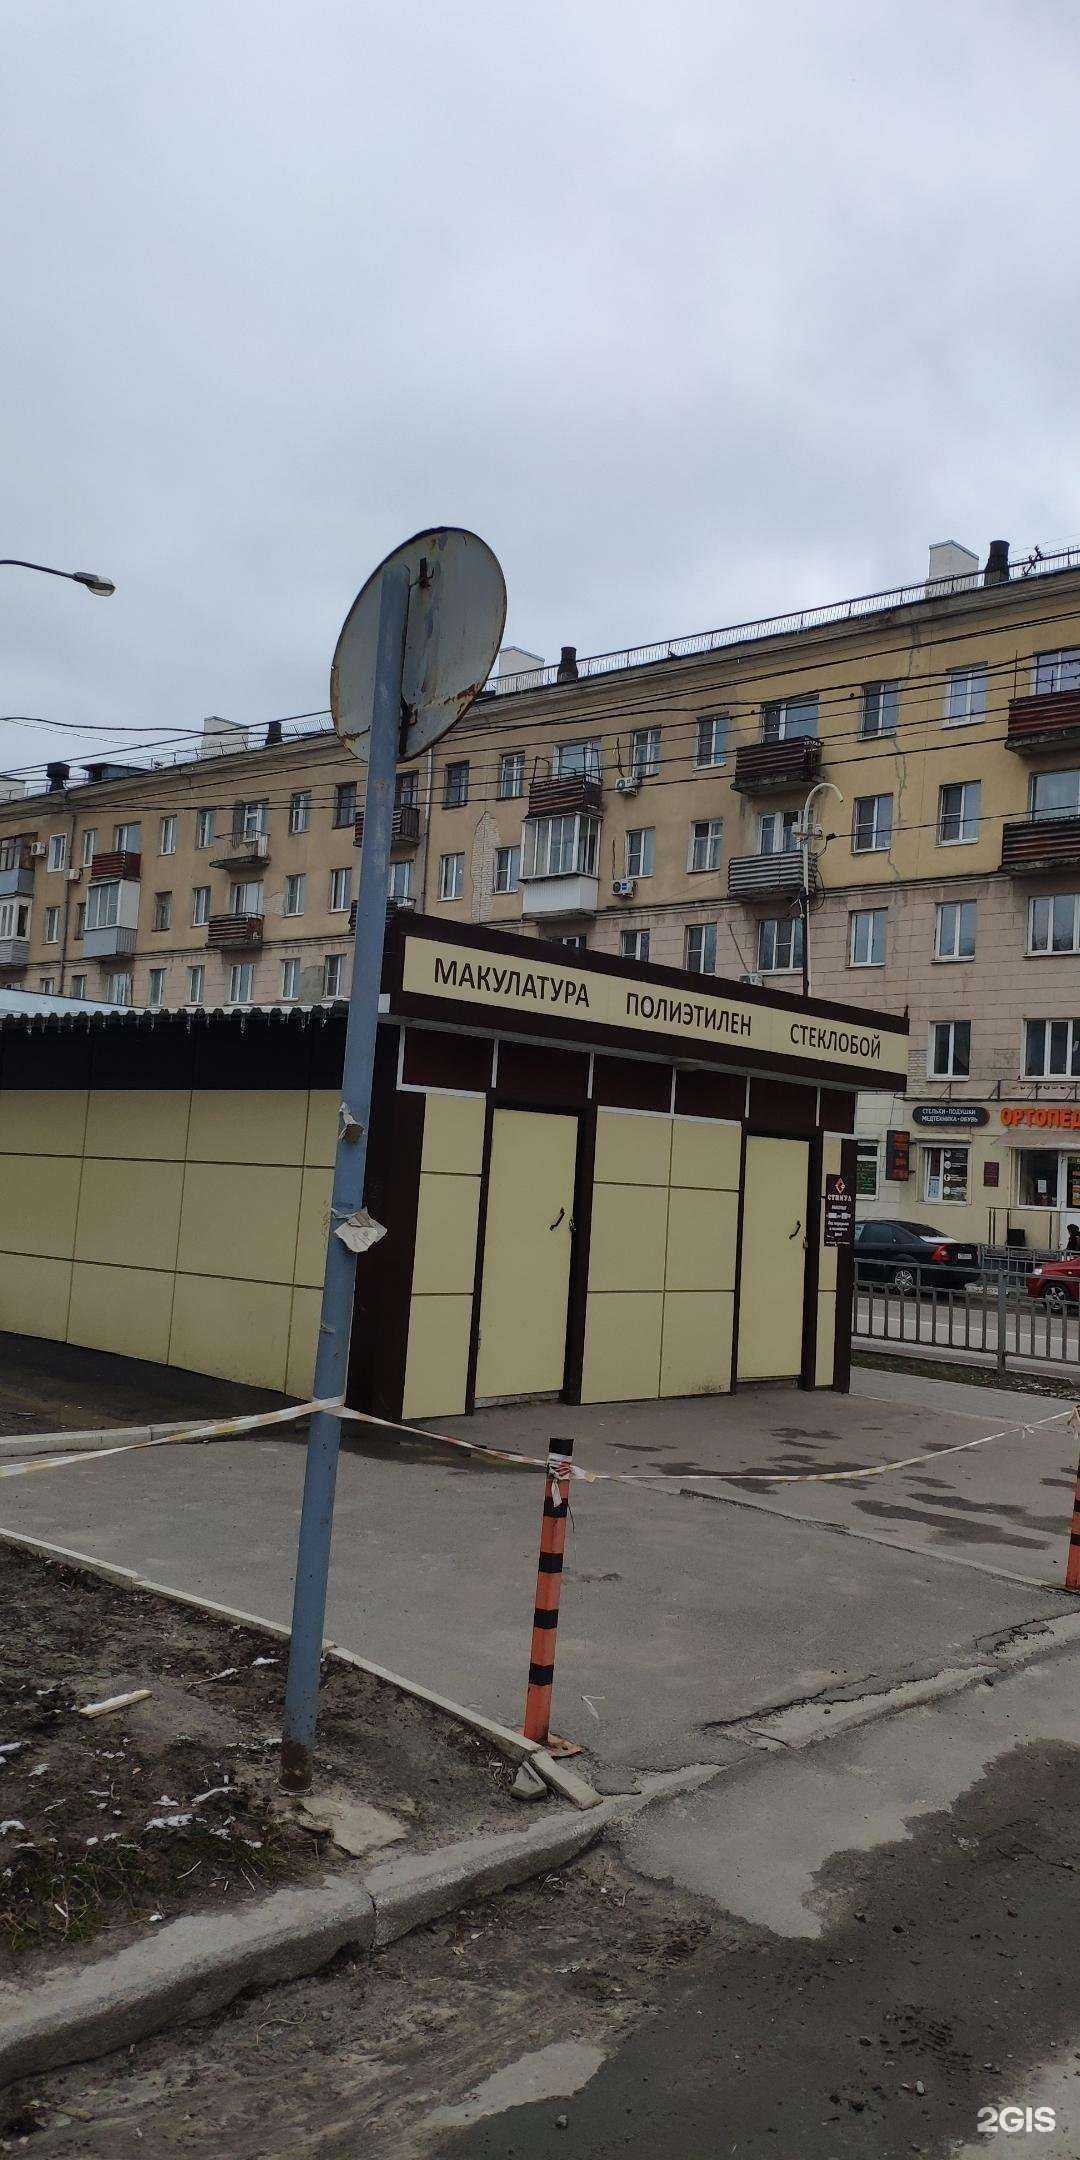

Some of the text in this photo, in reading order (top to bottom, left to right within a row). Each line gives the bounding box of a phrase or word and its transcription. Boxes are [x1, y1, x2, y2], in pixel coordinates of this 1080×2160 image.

[434, 957, 882, 1060] МАКУЛАТУРА ПОЛИЭТИЛЕН СТЕКЛОБОЙ
[949, 1108, 976, 1116] ПОДУШКИ
[921, 1115, 957, 1123] МЕДТЕХНИКА
